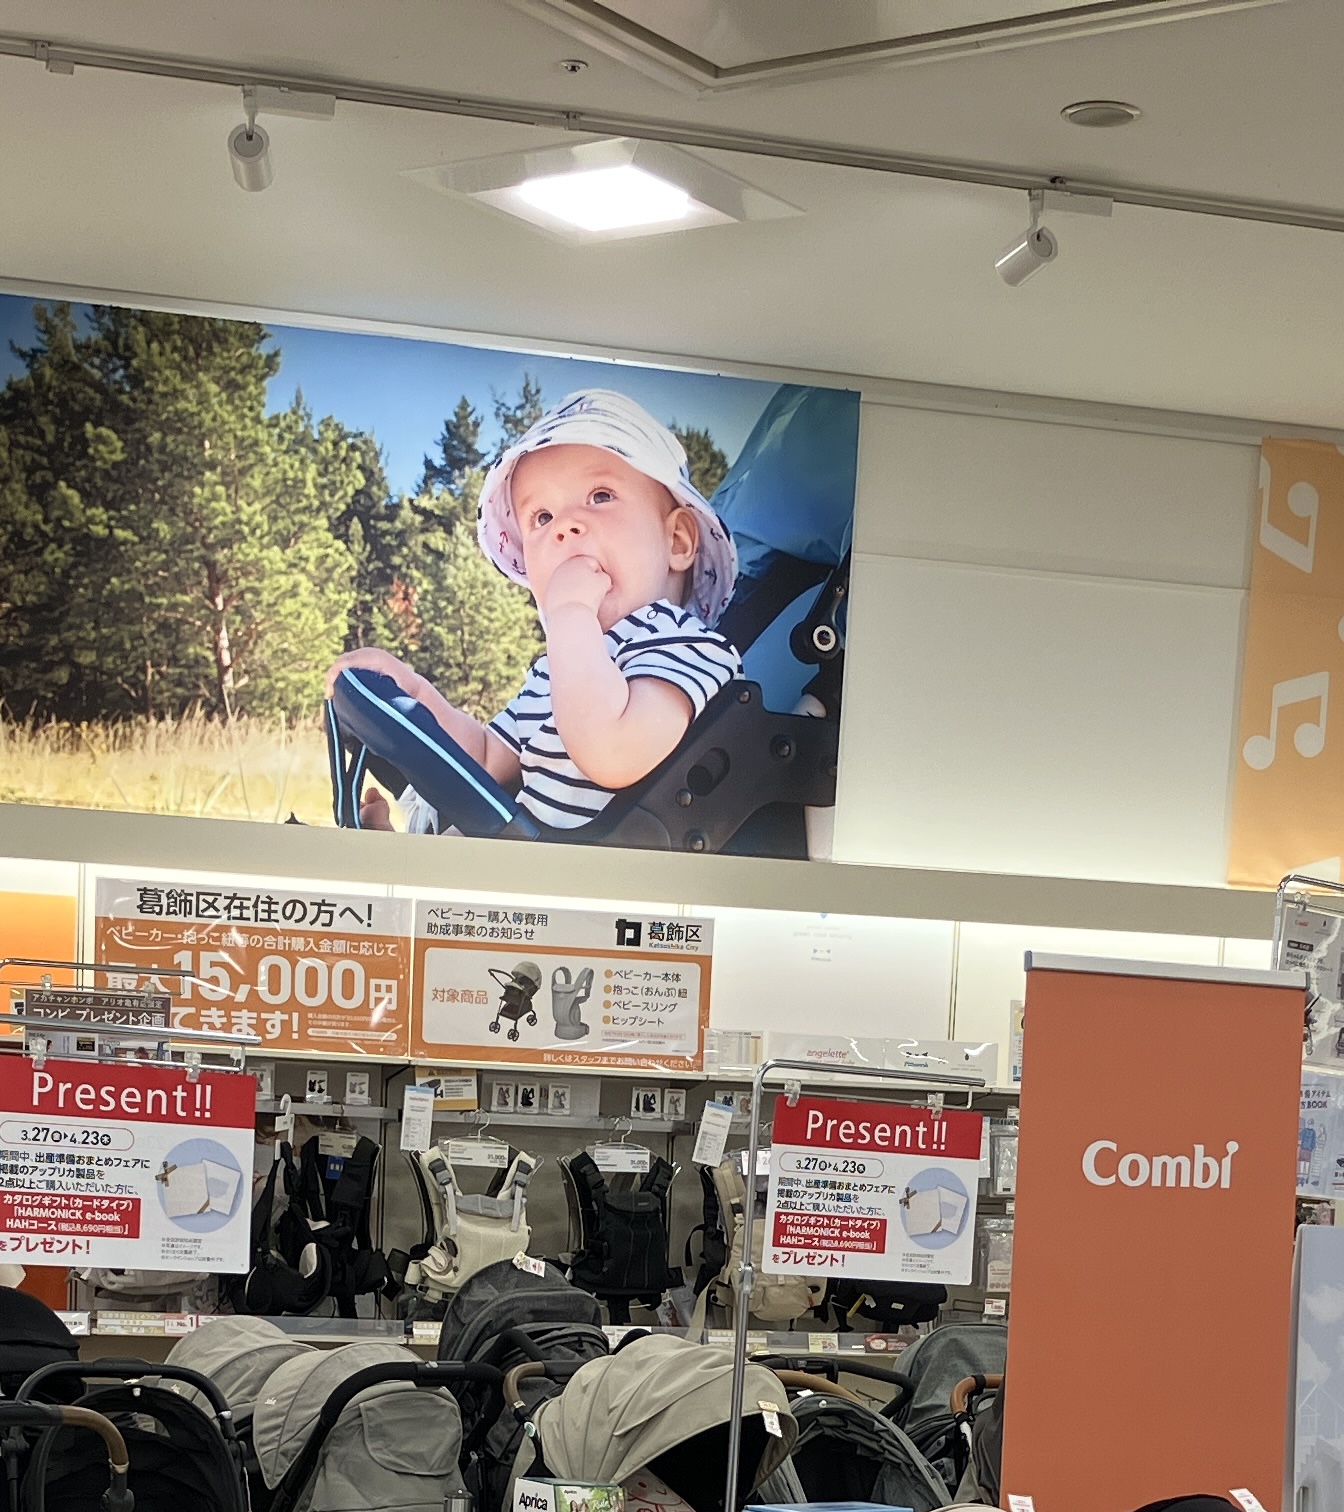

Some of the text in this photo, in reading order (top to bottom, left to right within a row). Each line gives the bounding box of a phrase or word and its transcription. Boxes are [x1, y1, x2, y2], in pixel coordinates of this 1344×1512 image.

[136, 887, 373, 928] 葛飾区在住の方へ!
[427, 907, 549, 927] ベビーカー購入等費用
[106, 925, 398, 957] ベビーカー・抱っこ紐等の合計購入金額に応じて
[426, 922, 535, 941] 助成事業のお知らせ
[647, 920, 704, 944] 葛飾区
[613, 968, 683, 984] ベビーカー本体
[431, 987, 489, 1005] 対象商品
[612, 999, 679, 1014] ベビースリング
[611, 1014, 666, 1028] ヒップシート
[32, 1071, 213, 1119] Present!!
[805, 1109, 948, 1150] Present!!
[1080, 1138, 1240, 1190] Combi
[777, 1176, 896, 1195] 期間中、出産準備おまとめフェアに
[776, 1188, 860, 1203] 掲載のアップリカ製品を
[84, 1209, 121, 1222] e-book
[776, 1199, 887, 1217] 2点以上ご購入いただいた方に、
[771, 1250, 846, 1268] をプレゼント!
[518, 1491, 549, 1512] Aprica
